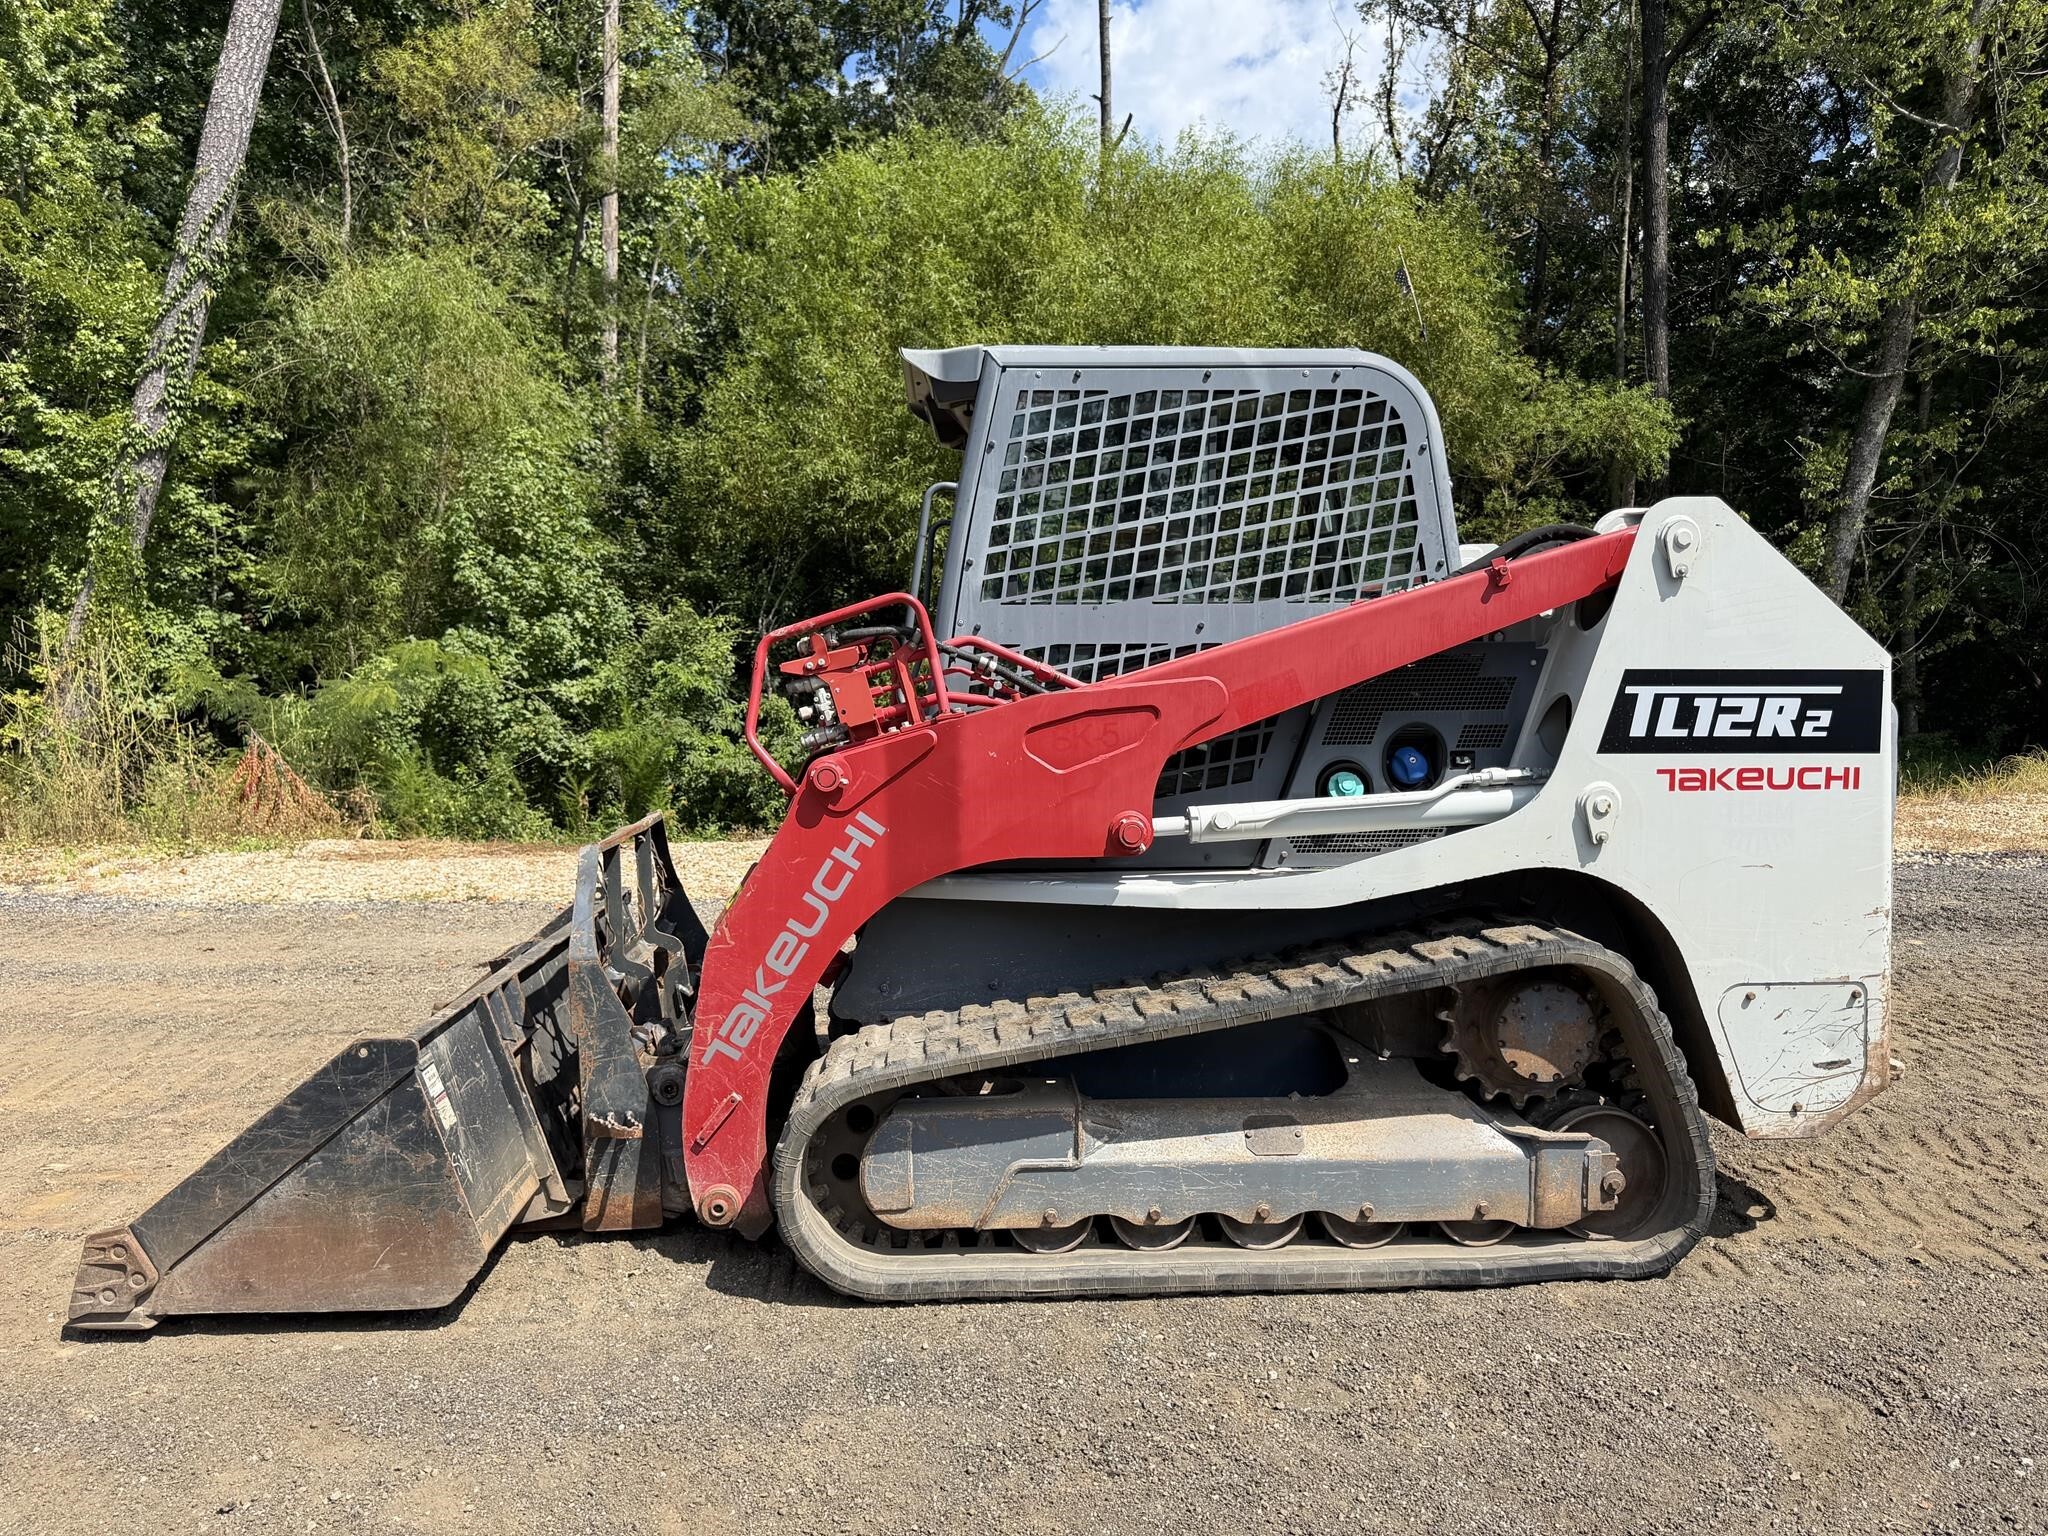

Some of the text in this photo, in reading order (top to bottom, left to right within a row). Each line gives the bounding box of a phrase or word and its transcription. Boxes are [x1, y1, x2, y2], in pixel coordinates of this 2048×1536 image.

[1625, 686, 1843, 737] TL12R2
[1656, 766, 1860, 791] TAKEUCHI
[701, 811, 886, 1066] TAKEUCHI
